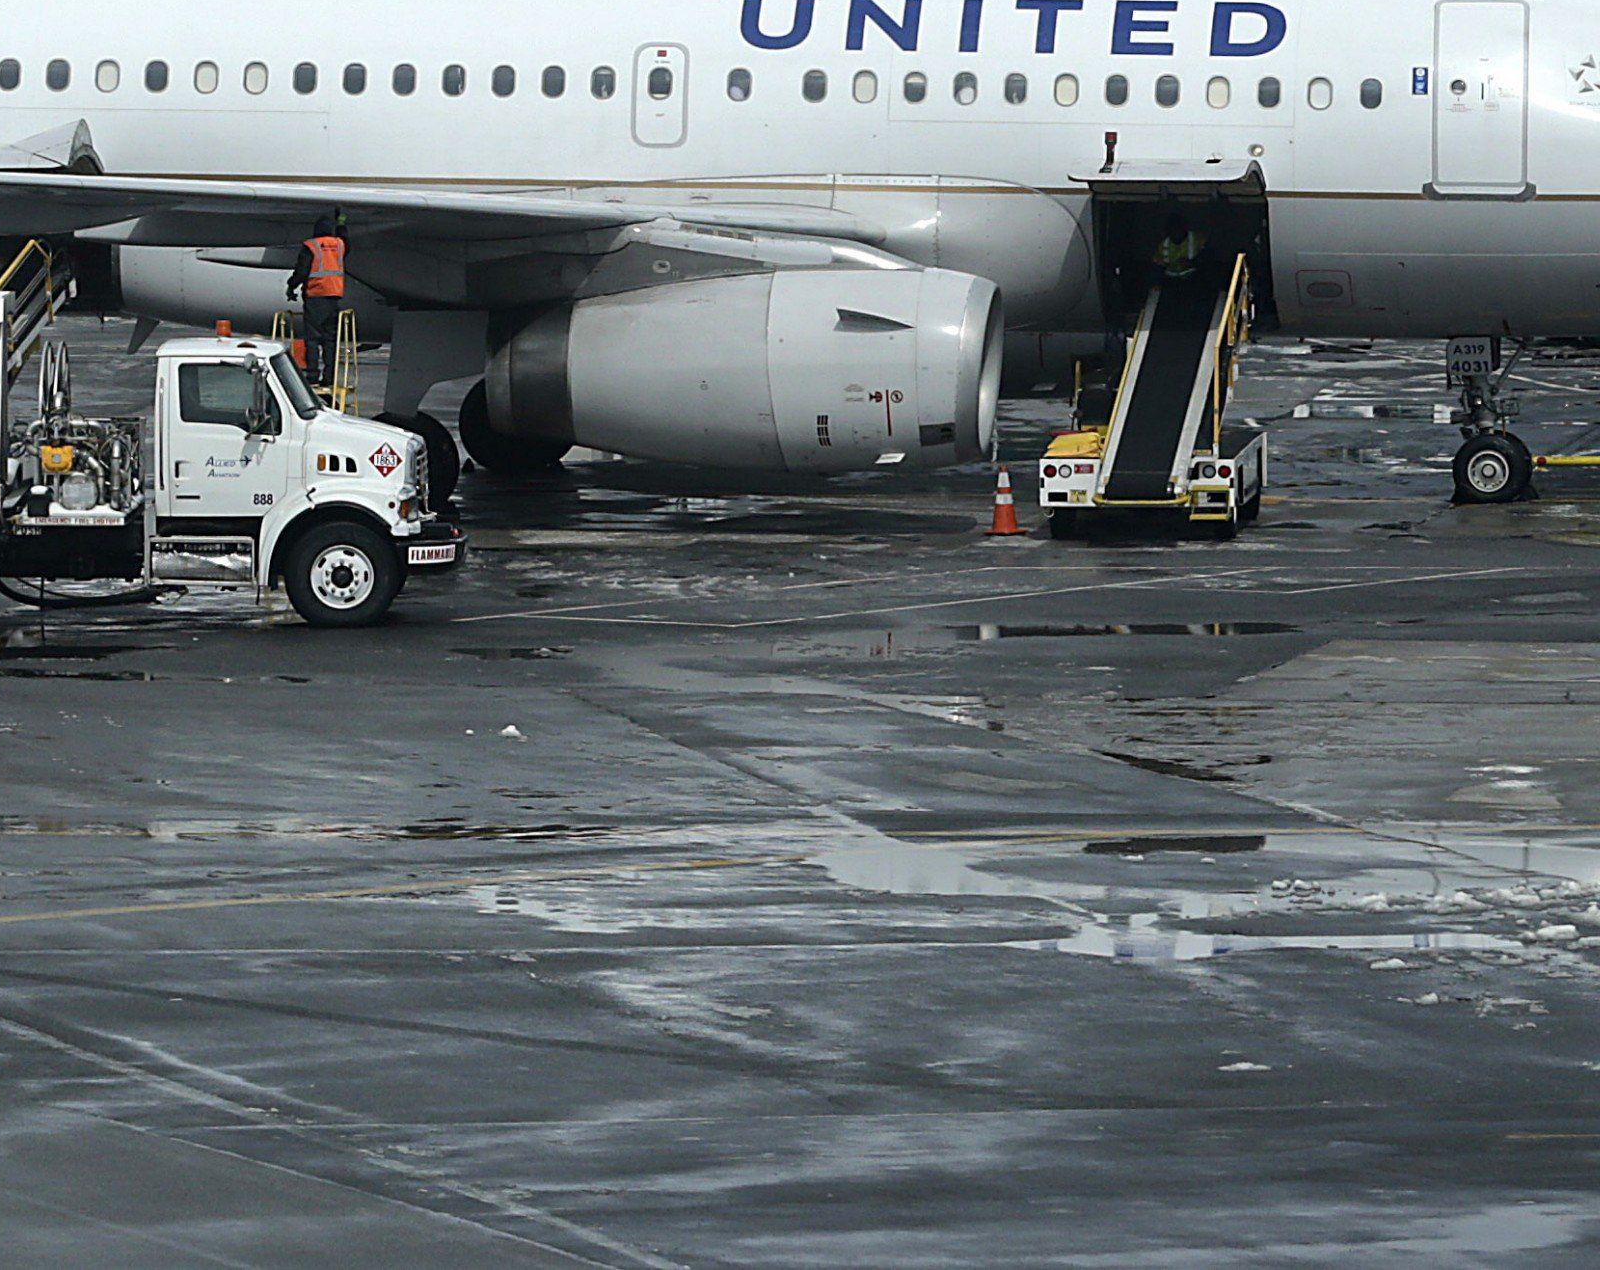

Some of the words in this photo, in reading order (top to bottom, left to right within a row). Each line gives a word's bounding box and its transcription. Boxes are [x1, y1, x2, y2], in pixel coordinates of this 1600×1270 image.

[1453, 344, 1485, 355] A319
[1450, 360, 1489, 372] 4031
[375, 454, 397, 466] 1863
[253, 493, 274, 505] 888
